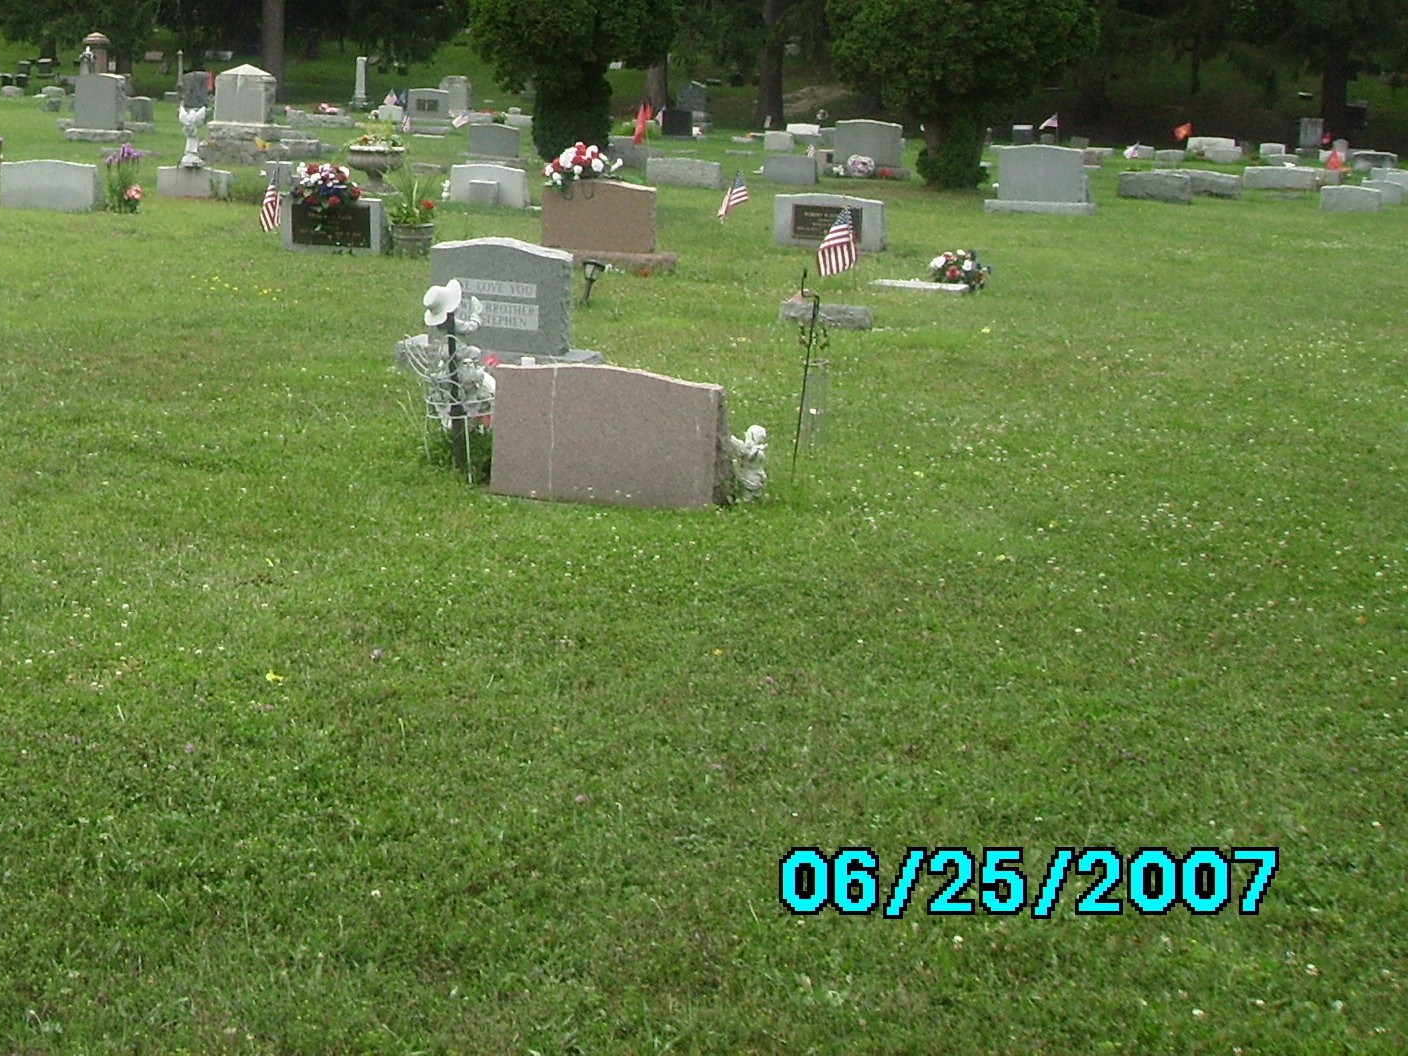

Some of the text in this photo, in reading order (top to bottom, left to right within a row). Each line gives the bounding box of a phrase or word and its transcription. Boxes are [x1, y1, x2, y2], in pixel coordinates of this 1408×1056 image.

[477, 281, 504, 293] LOVE
[510, 284, 533, 296] YOU
[485, 303, 535, 317] BROTHER
[479, 313, 527, 327] STEPHEN
